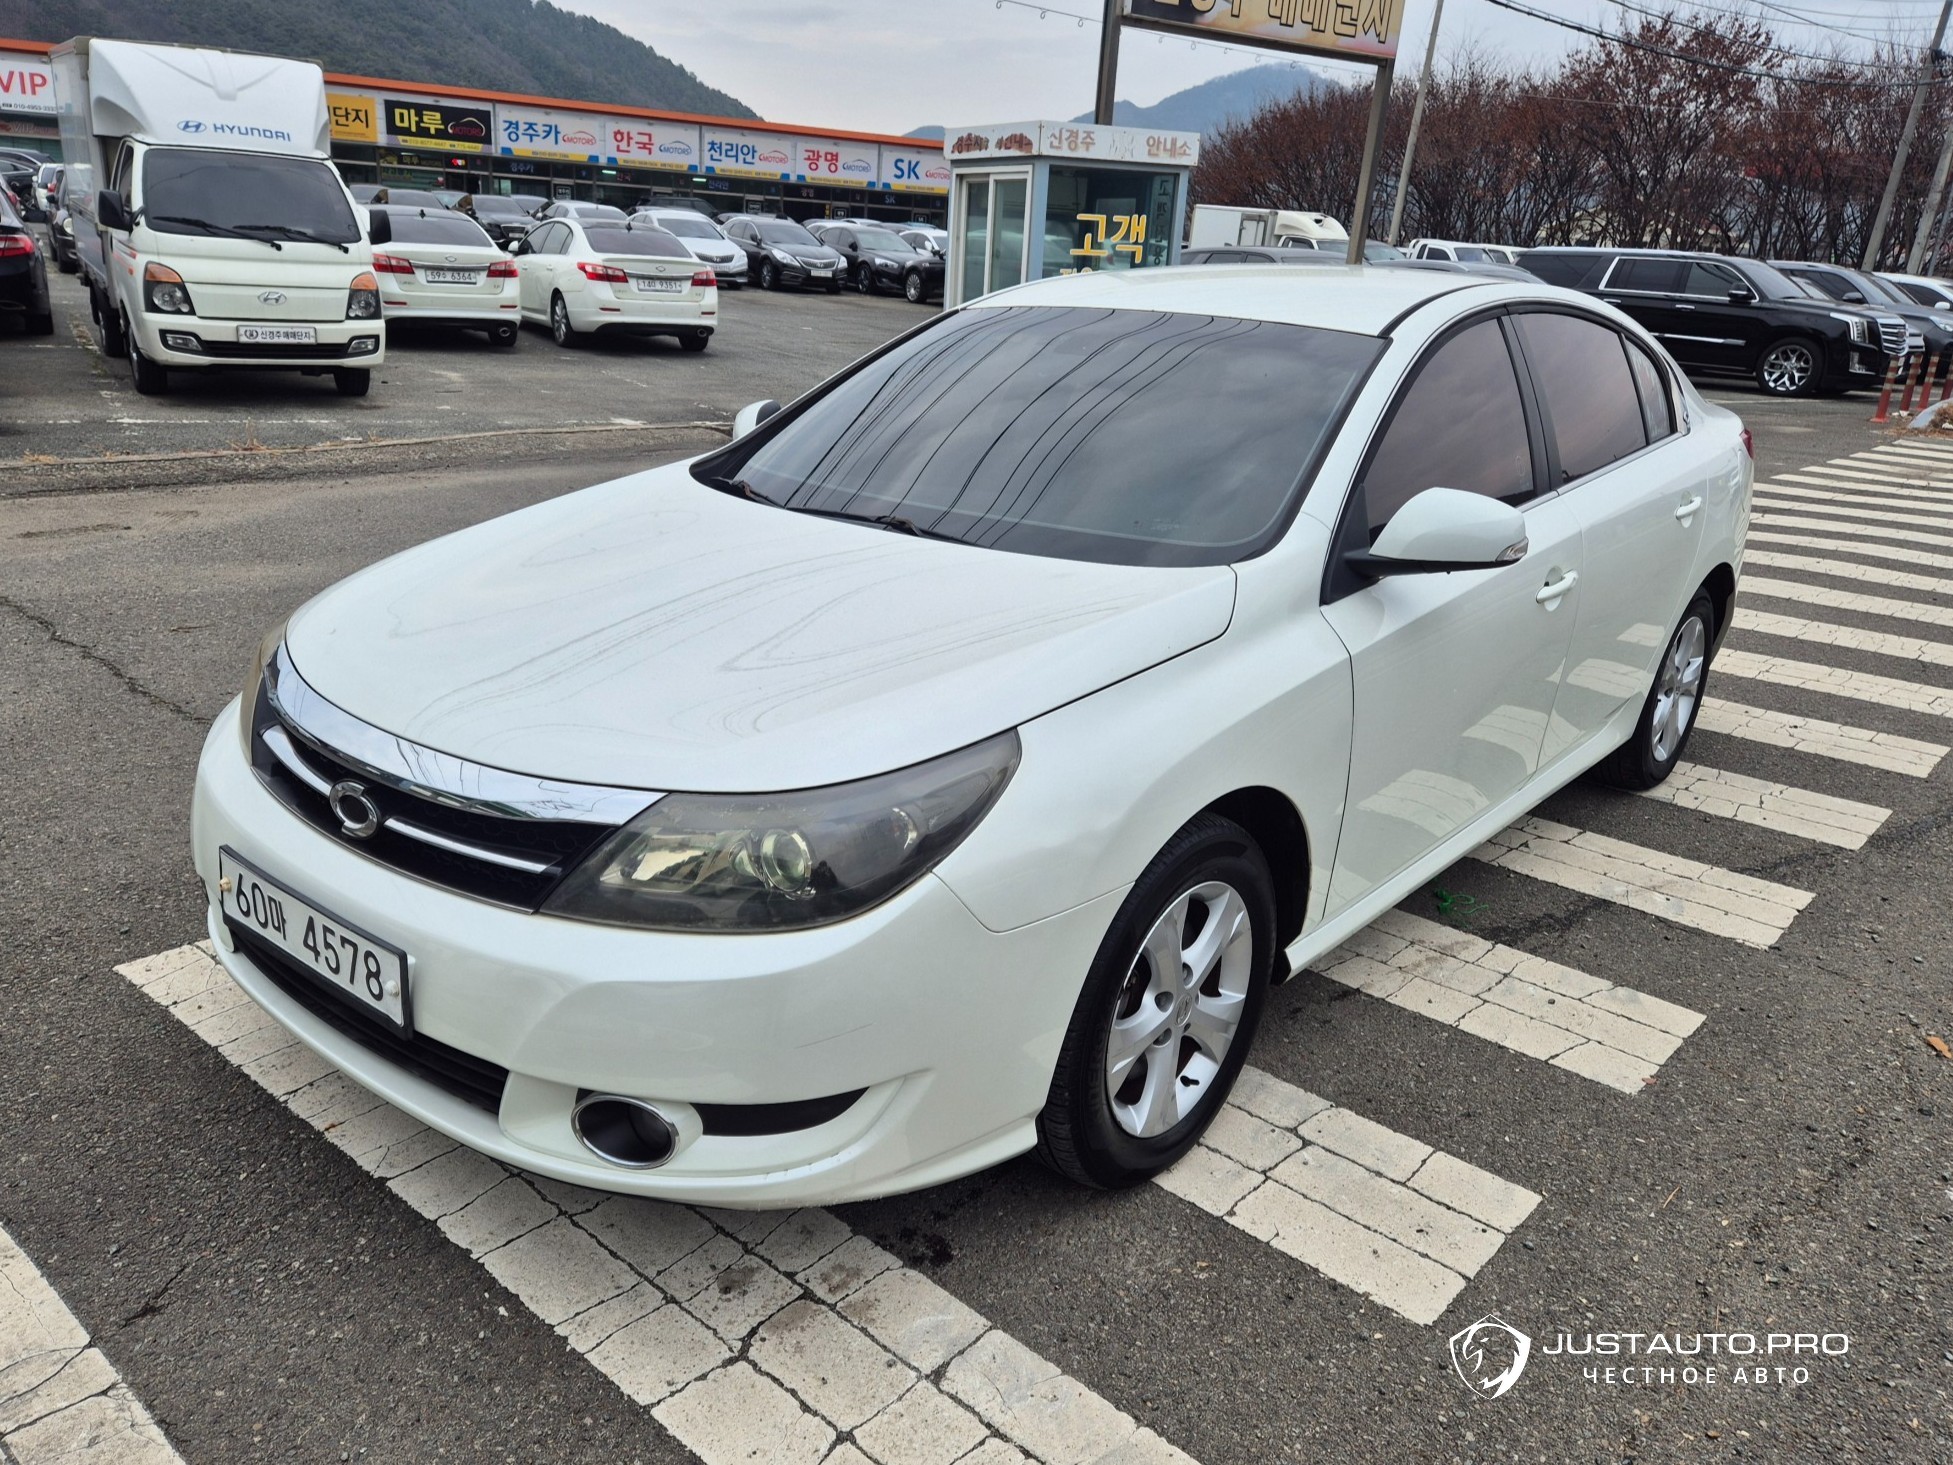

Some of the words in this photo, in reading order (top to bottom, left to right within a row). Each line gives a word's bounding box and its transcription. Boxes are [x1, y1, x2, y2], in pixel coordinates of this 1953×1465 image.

[0, 70, 47, 95] VIP
[328, 105, 369, 128] 단지
[394, 108, 444, 135] 마루
[213, 123, 291, 142] HYUNDAI
[452, 126, 482, 136] MOTORS
[503, 120, 561, 145] 경주카
[565, 137, 594, 145] MOTORS
[613, 129, 654, 155] 한국
[663, 145, 691, 155] MOTORS
[708, 140, 757, 165] 천리안
[1049, 127, 1096, 152] 신경주
[1146, 134, 1192, 158] 안내소
[761, 154, 788, 164] MOTORS
[804, 149, 839, 173] 광명
[845, 164, 870, 173] MOTORS
[894, 158, 920, 180] SK
[928, 170, 950, 180] MOTORS
[1070, 213, 1147, 264] 고객
[450, 272, 472, 281] 6364
[260, 330, 281, 340] 신경주
[235, 872, 288, 941] 60마
[302, 915, 384, 1002] 4578
